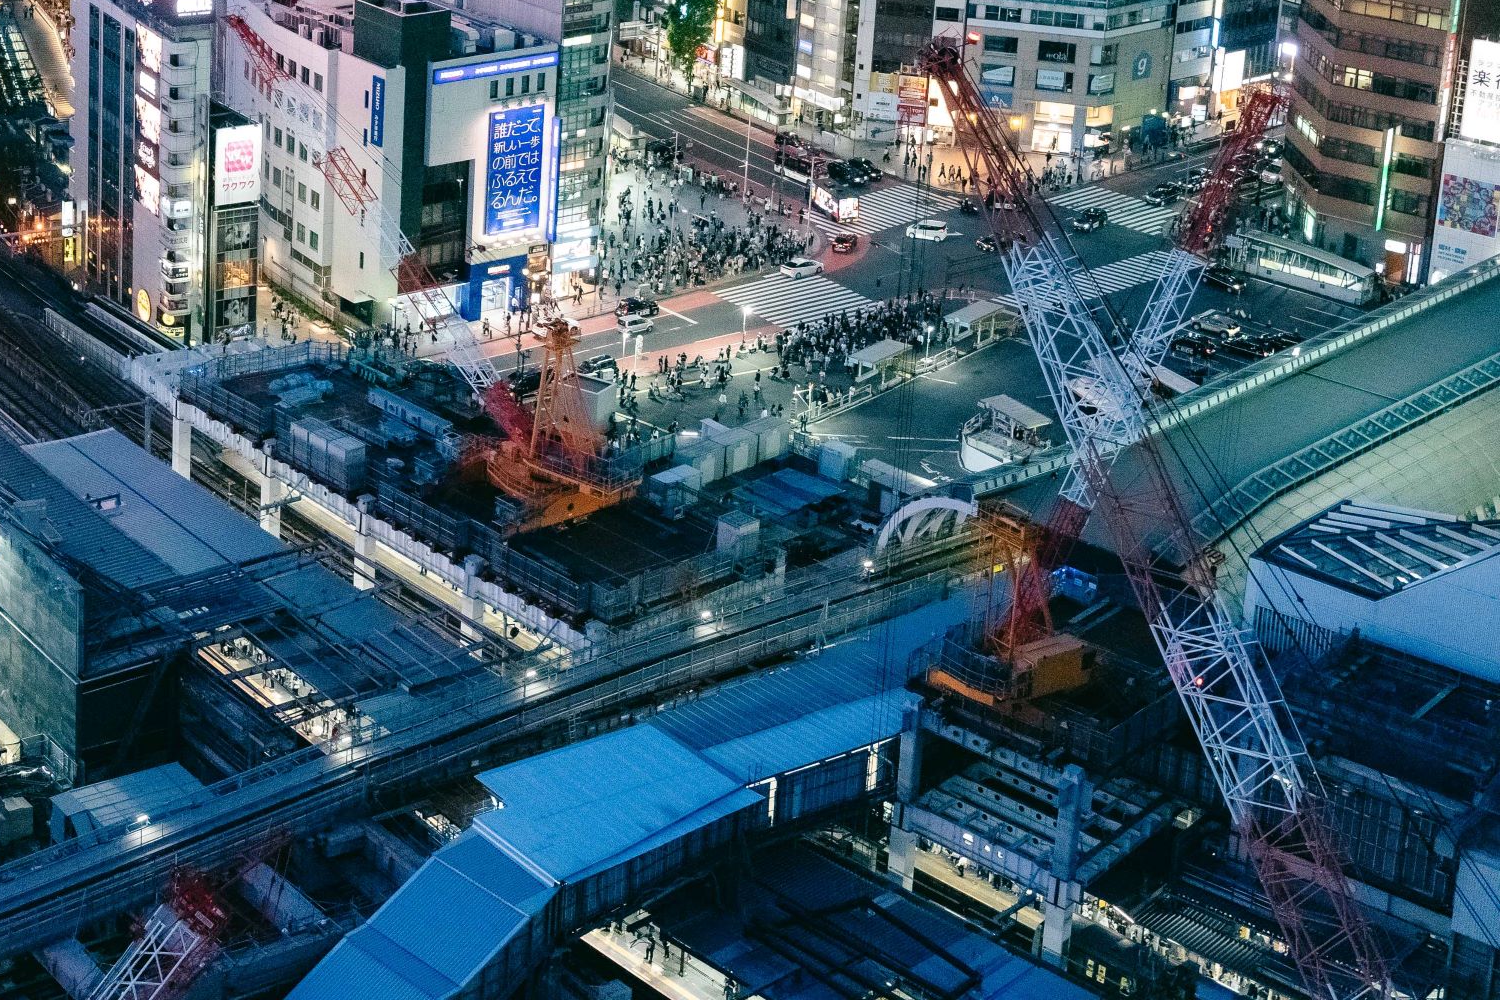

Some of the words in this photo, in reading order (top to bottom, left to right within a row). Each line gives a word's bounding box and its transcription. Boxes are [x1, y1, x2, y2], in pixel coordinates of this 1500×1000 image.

[494, 117, 541, 140] 誰だって、
[493, 136, 540, 154] 新しい一歩
[492, 151, 540, 171] の前では
[222, 180, 255, 192] ワクワク
[491, 167, 538, 189] ふるえて
[490, 185, 538, 210] るんだ。
